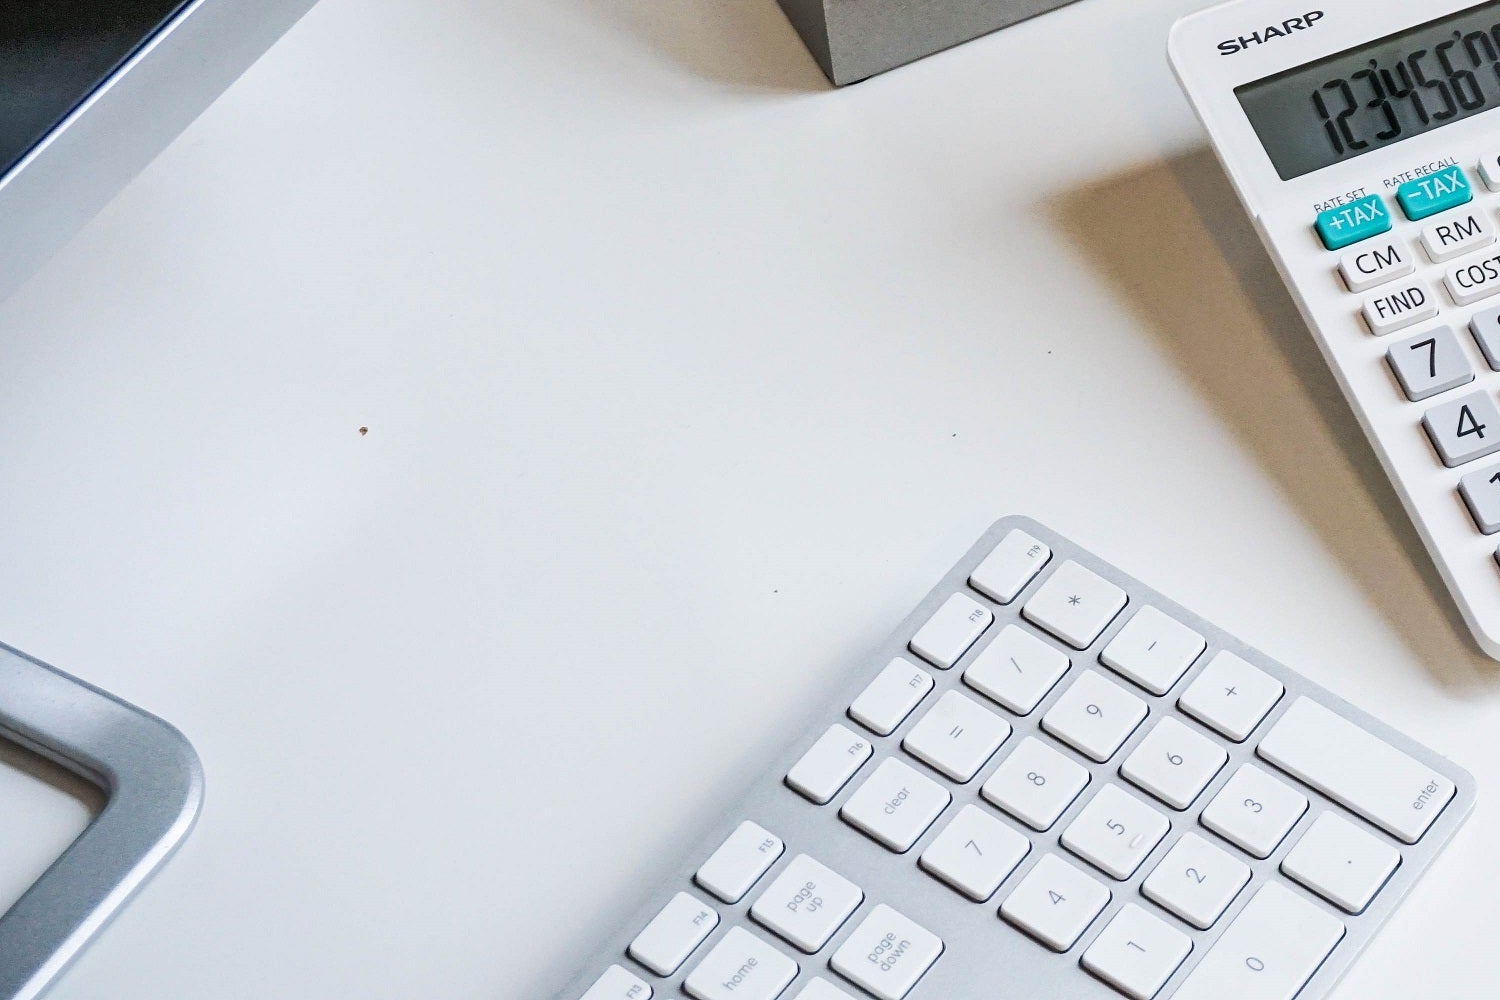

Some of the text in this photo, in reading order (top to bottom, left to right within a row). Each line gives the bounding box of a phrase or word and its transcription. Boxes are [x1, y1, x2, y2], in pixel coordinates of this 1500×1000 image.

[1217, 9, 1325, 56] SHARP
[1383, 156, 1459, 189] RATE RECALL
[1314, 187, 1367, 213] RATE SET
[1329, 199, 1384, 230] +TAX
[1436, 215, 1482, 246] RM
[1355, 244, 1402, 274] CM
[1373, 286, 1426, 319] FIND
[1410, 338, 1437, 378] 7
[1456, 404, 1487, 439] 4
[1027, 544, 1042, 558] F19
[968, 609, 984, 623] F18
[909, 674, 924, 688] F17
[1086, 703, 1103, 718] 9
[847, 742, 864, 756] F16
[1166, 751, 1184, 766] 6
[1027, 771, 1046, 786] 8
[884, 786, 911, 815] clear
[1413, 778, 1440, 811] enter
[1243, 798, 1264, 813] 3
[1106, 819, 1126, 836] 5
[757, 838, 775, 854] F15
[964, 840, 983, 856] 7
[1185, 867, 1207, 884] 2
[786, 880, 817, 913] page
[806, 896, 823, 913] up
[1048, 889, 1067, 905] 4
[692, 911, 709, 926] F14
[867, 931, 897, 963] page
[879, 939, 912, 972] down
[1126, 941, 1146, 953] 1
[1245, 956, 1265, 972] 0
[722, 956, 759, 992] home
[625, 984, 643, 999] F13
